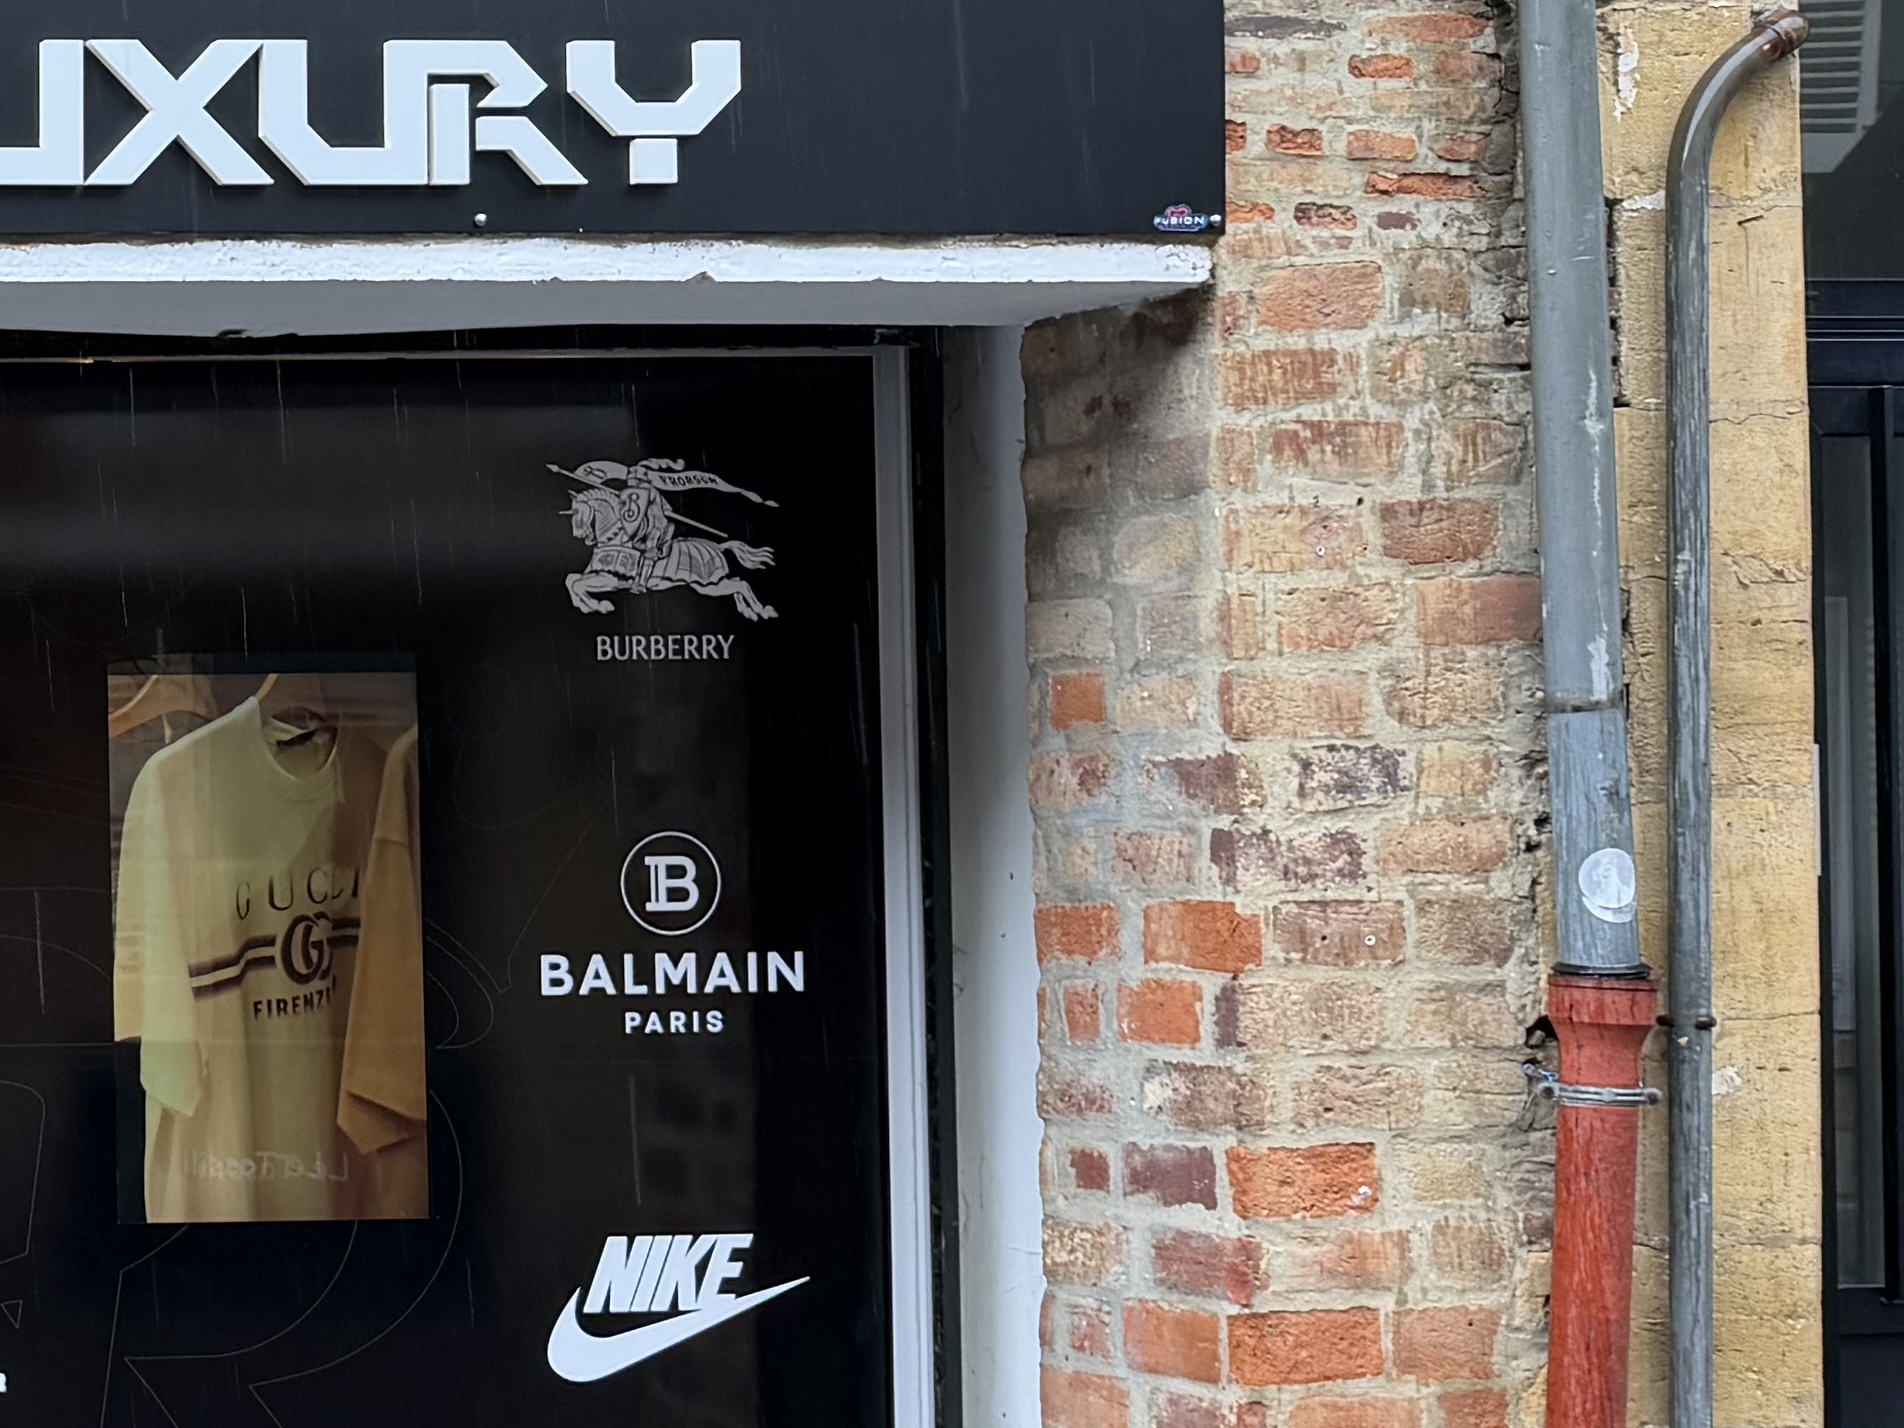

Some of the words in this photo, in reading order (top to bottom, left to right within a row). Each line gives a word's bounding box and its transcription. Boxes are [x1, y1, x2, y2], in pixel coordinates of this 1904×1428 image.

[596, 634, 735, 661] BURBERRY
[539, 950, 805, 997] BALMAIN
[624, 1010, 724, 1035] PARIS
[583, 1233, 754, 1313] NIKE
